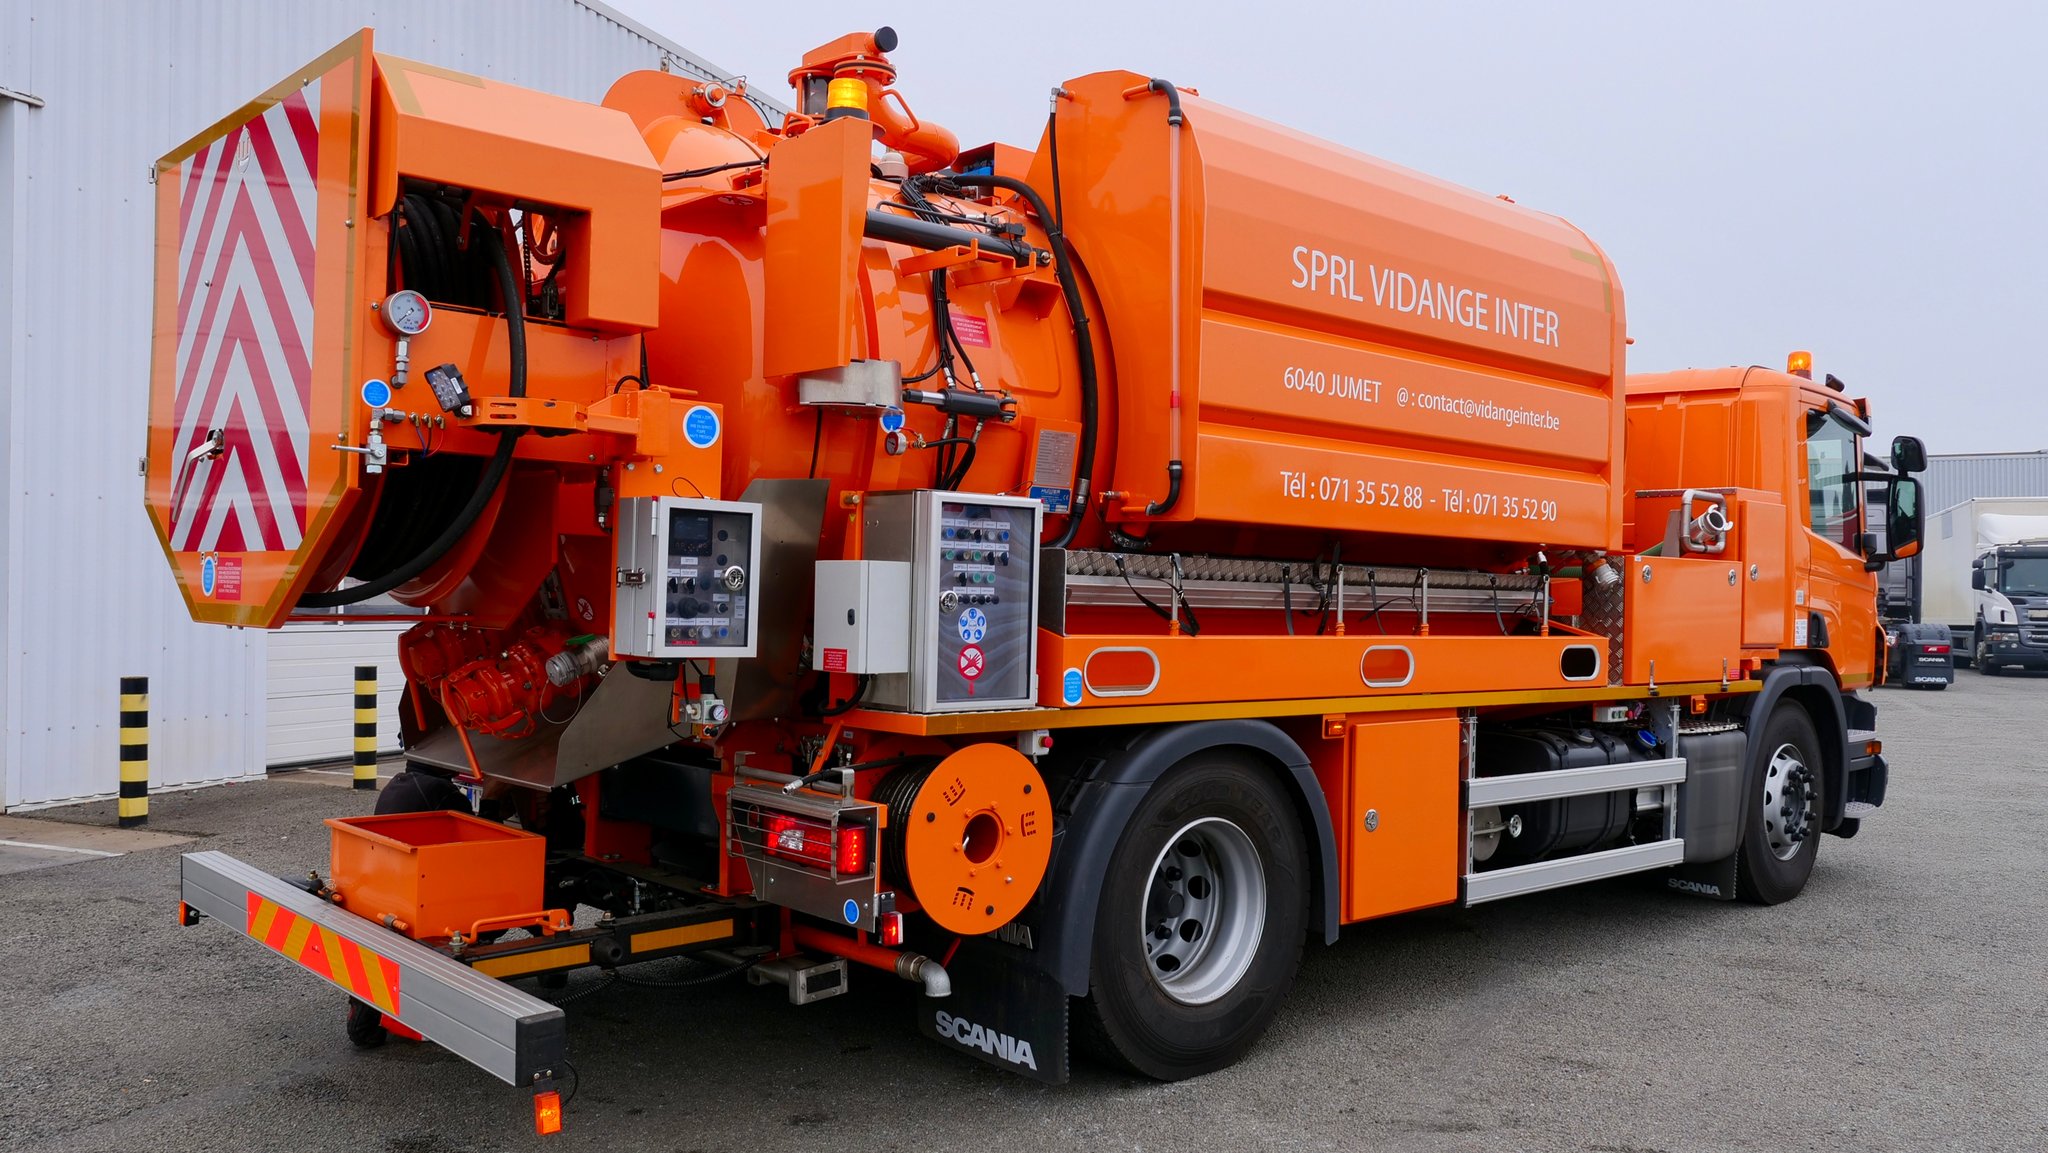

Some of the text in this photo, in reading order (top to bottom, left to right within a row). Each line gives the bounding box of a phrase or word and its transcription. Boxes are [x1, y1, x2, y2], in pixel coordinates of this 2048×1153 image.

[1292, 245, 1560, 348] SPRL VIDANGE INTER
[1283, 366, 1325, 394] 6040
[1328, 373, 1382, 403] JUMET
[1396, 387, 1409, 407] @
[1417, 393, 1560, 431] contact@vidangeinter.be
[1280, 471, 1306, 499] Tél
[1319, 476, 1349, 502] 071
[1356, 479, 1376, 505] 35
[1380, 483, 1399, 507] 52
[1404, 485, 1423, 509] 88
[1442, 488, 1463, 513] Tél
[1473, 492, 1497, 516] 071
[1502, 495, 1519, 518] 35
[1522, 498, 1538, 520] 52
[1541, 500, 1557, 522] 90
[1667, 877, 1721, 897] SCANIA
[935, 1009, 1038, 1071] SCANIA
